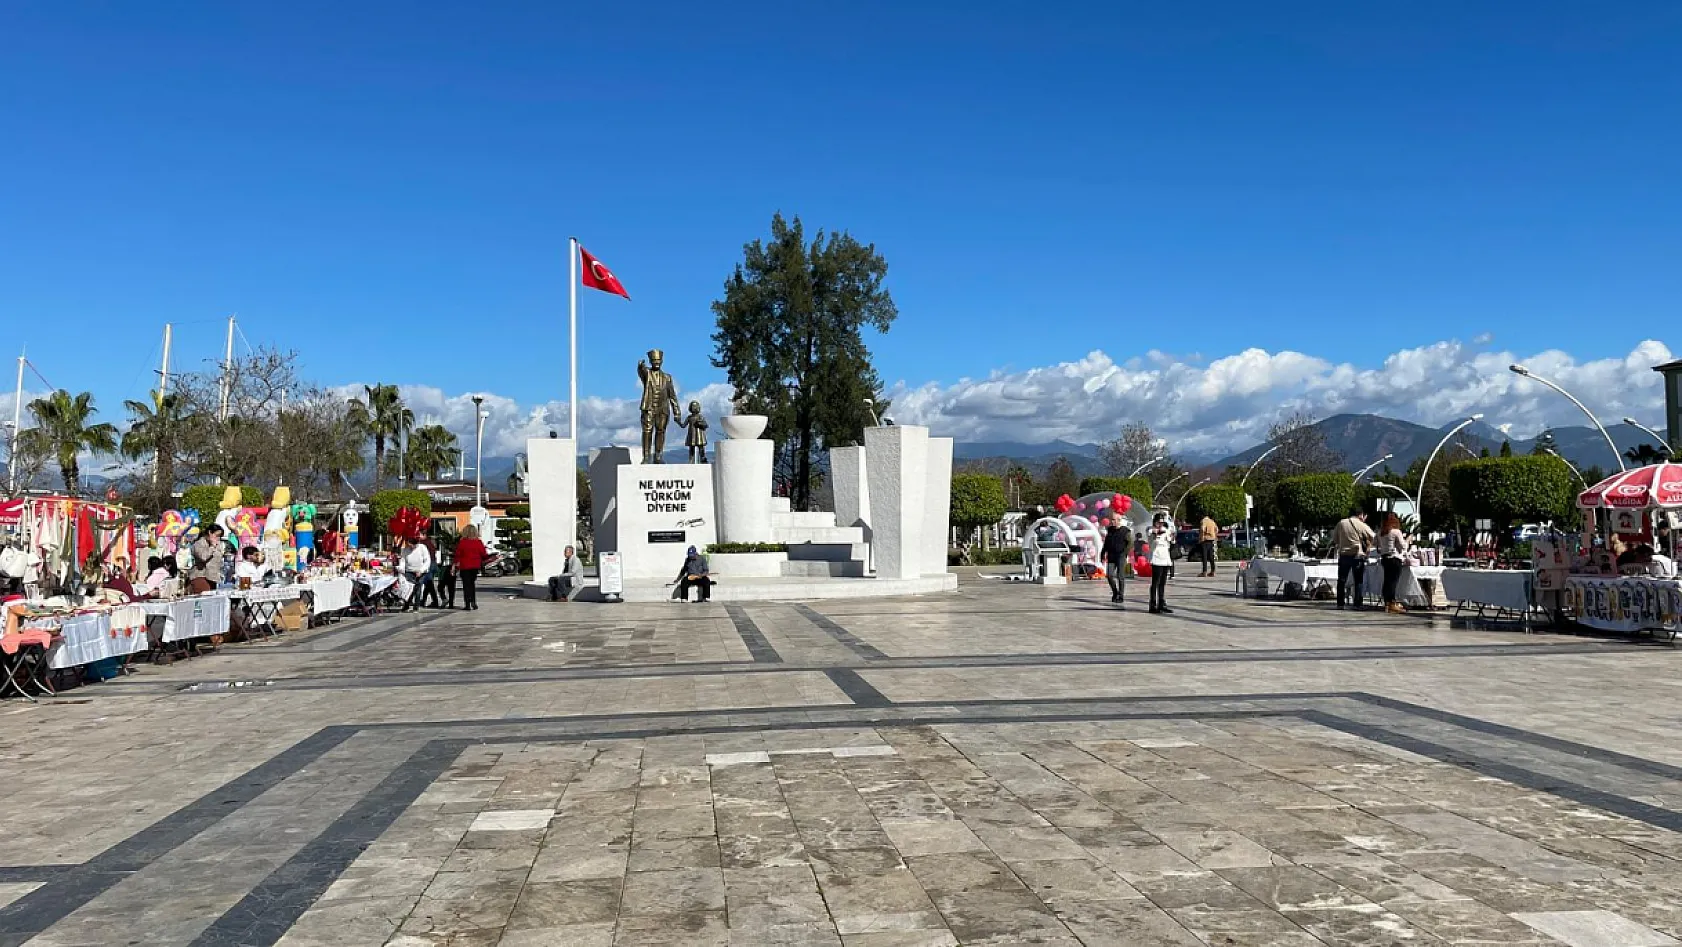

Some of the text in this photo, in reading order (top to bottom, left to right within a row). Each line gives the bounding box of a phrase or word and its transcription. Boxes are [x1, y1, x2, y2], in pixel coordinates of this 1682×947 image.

[639, 479, 694, 489] NE MUTLU
[644, 489, 691, 501] TÜRKÜM
[647, 501, 687, 512] DİYENE
